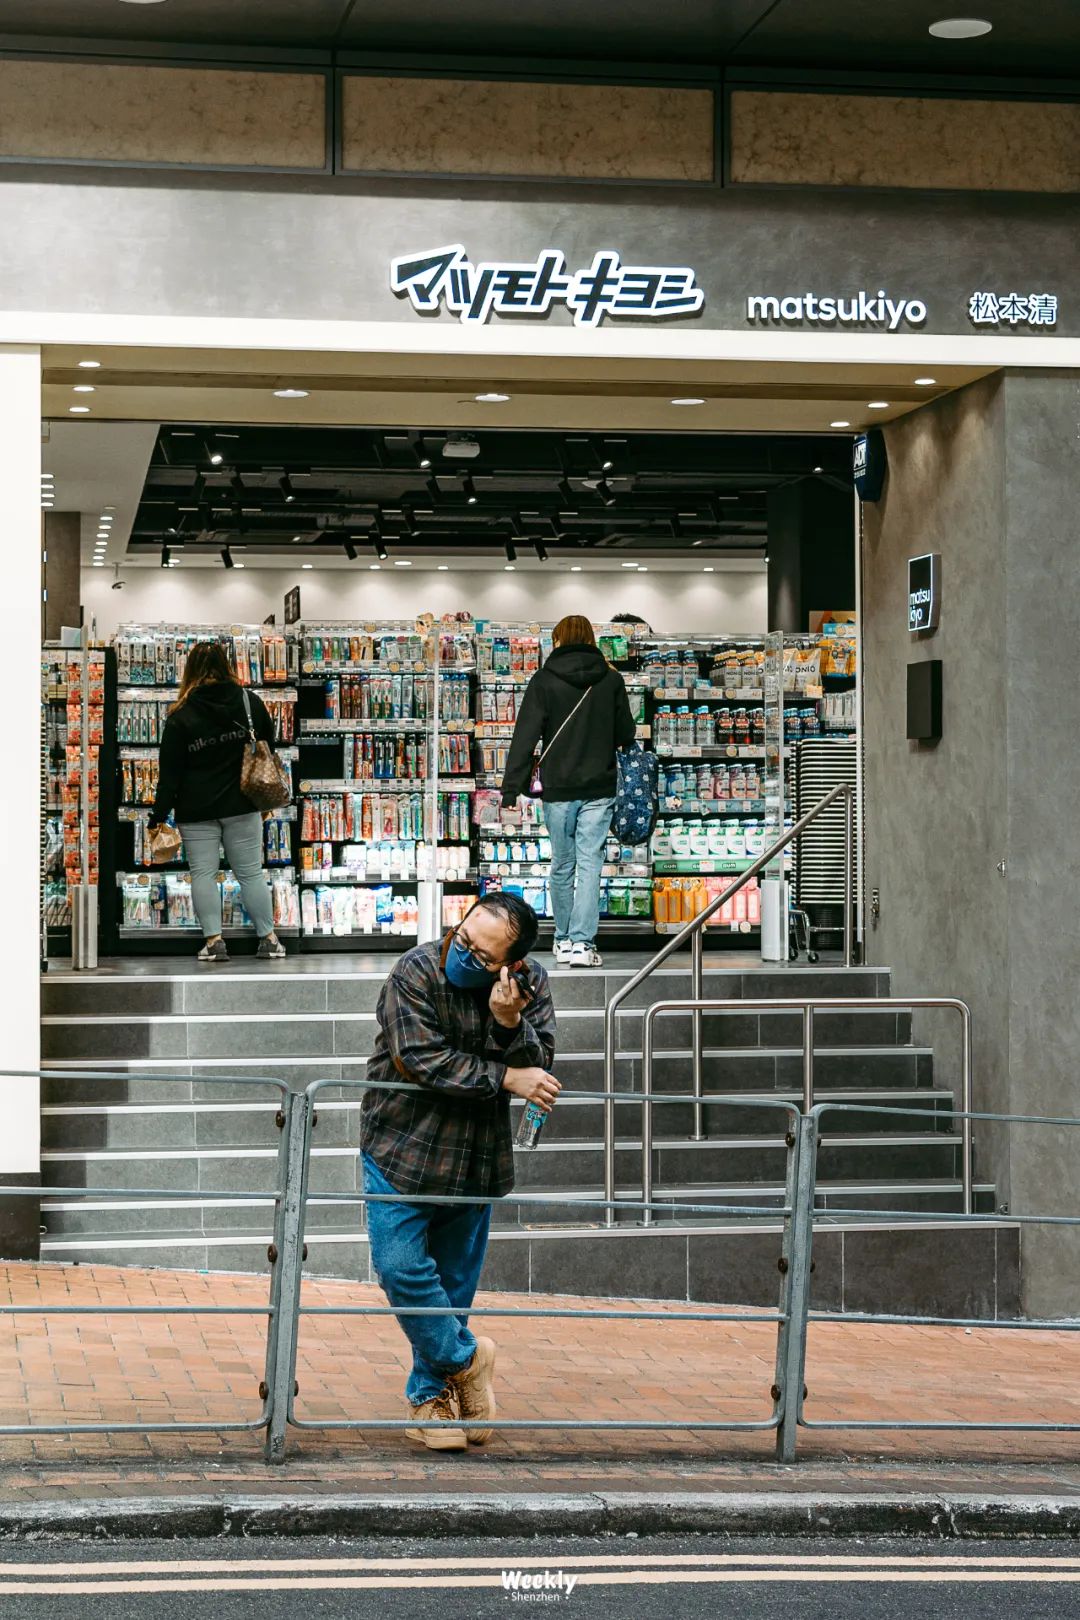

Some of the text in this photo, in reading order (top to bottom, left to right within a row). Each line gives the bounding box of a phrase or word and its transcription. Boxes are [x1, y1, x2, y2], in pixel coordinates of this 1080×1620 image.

[747, 290, 927, 329] matsukiyo
[969, 292, 1058, 325] 松本清
[910, 589, 930, 605] matsu
